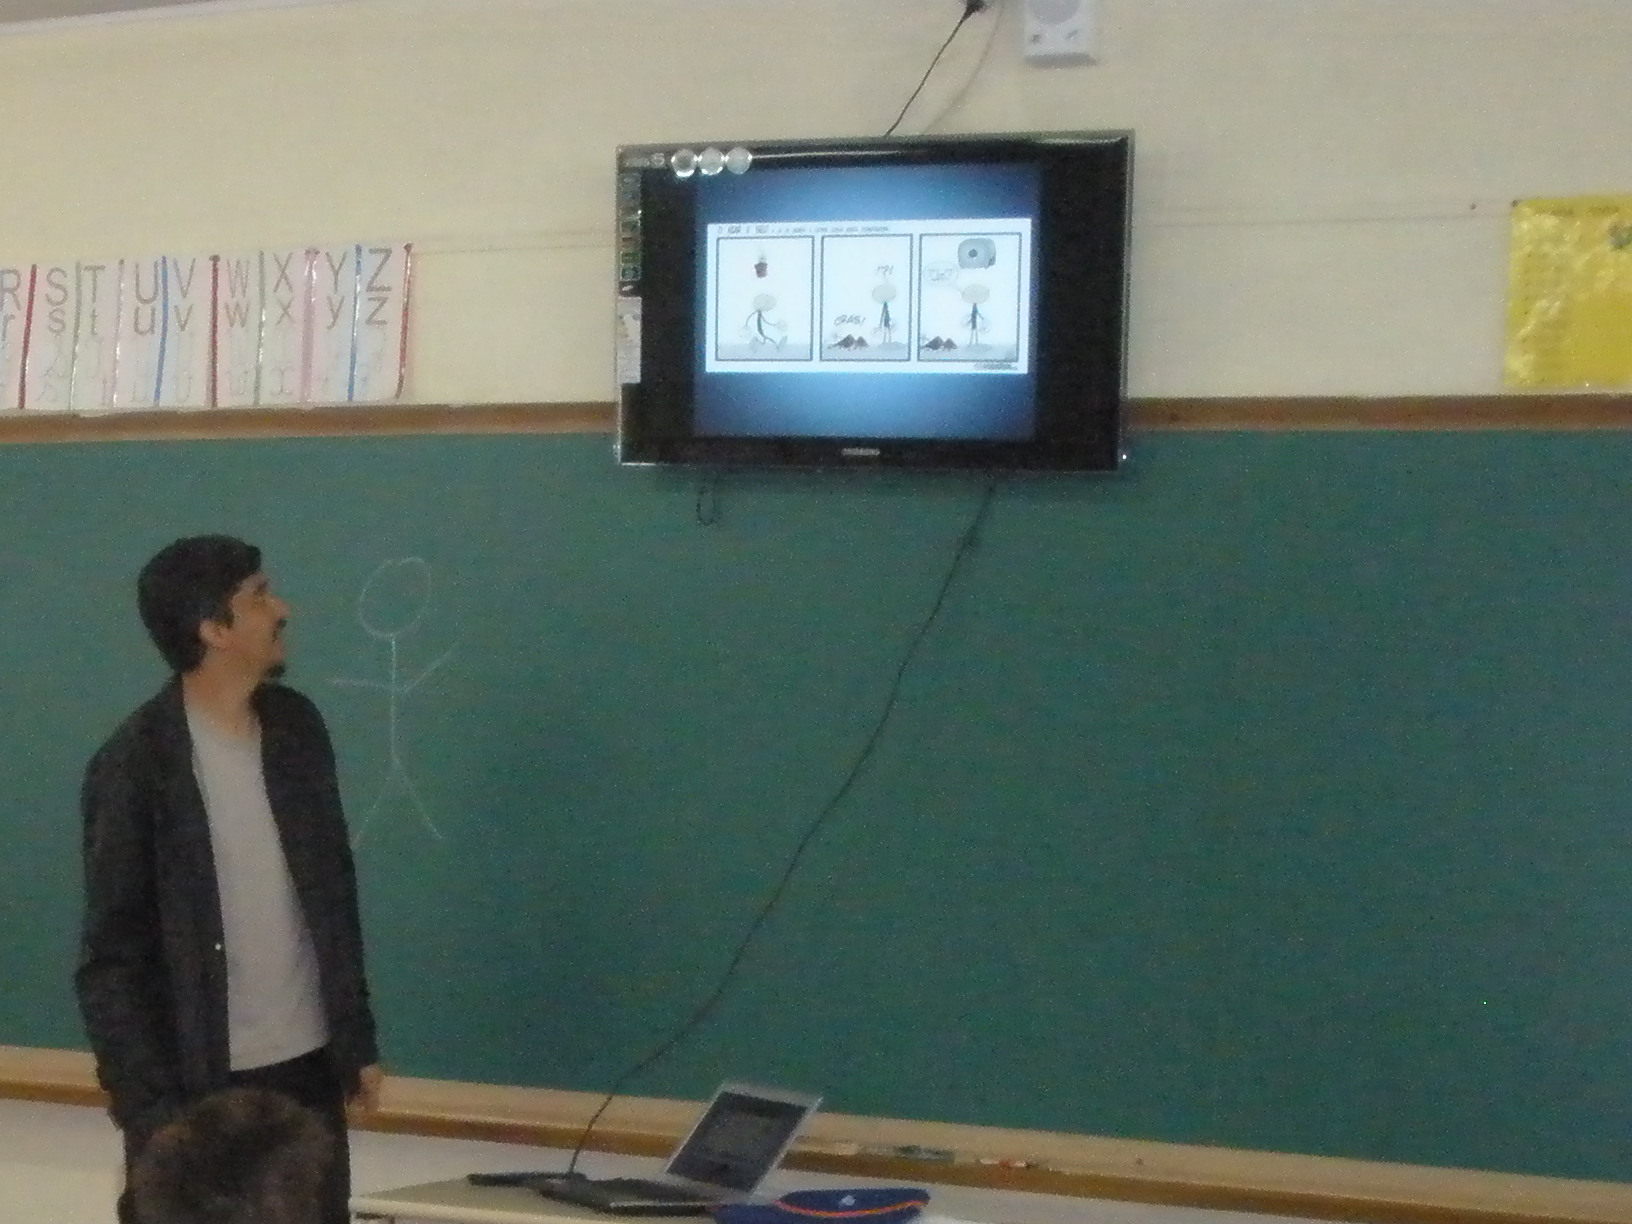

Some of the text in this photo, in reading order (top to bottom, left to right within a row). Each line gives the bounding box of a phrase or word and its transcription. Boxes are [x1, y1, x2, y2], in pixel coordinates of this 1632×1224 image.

[0, 269, 21, 311] R
[45, 267, 68, 306] S
[84, 265, 106, 303] T
[135, 261, 159, 304] U
[173, 257, 196, 298] V
[227, 258, 250, 298] W
[274, 252, 293, 292] X
[325, 251, 347, 294] Y
[366, 248, 392, 292] Z
